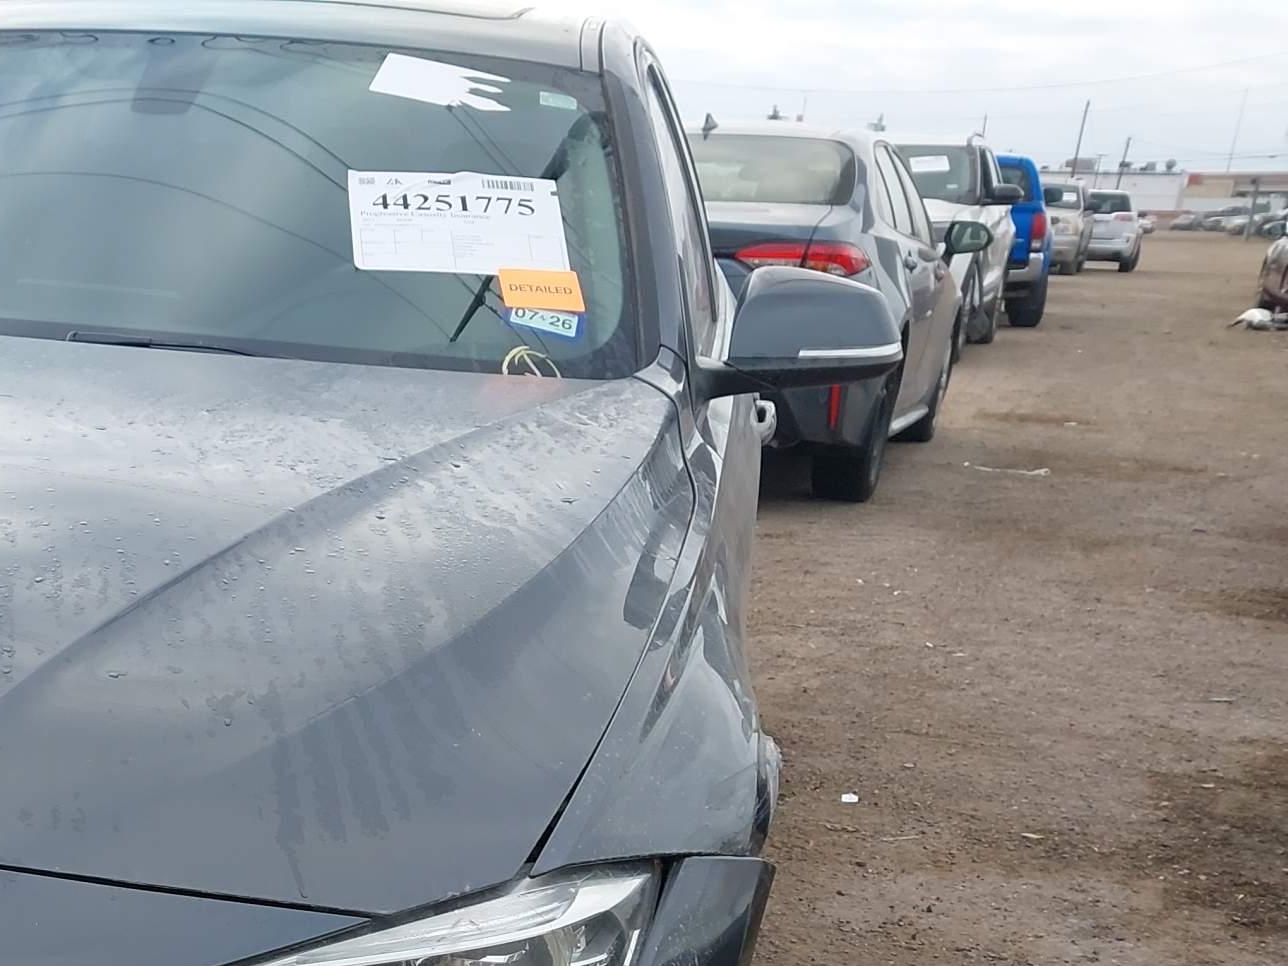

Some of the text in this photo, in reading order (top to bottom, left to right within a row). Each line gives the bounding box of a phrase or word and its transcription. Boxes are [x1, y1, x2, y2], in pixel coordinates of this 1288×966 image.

[372, 192, 535, 216] 44251775
[508, 283, 573, 295] DETAILED
[514, 308, 573, 330] 07 26
